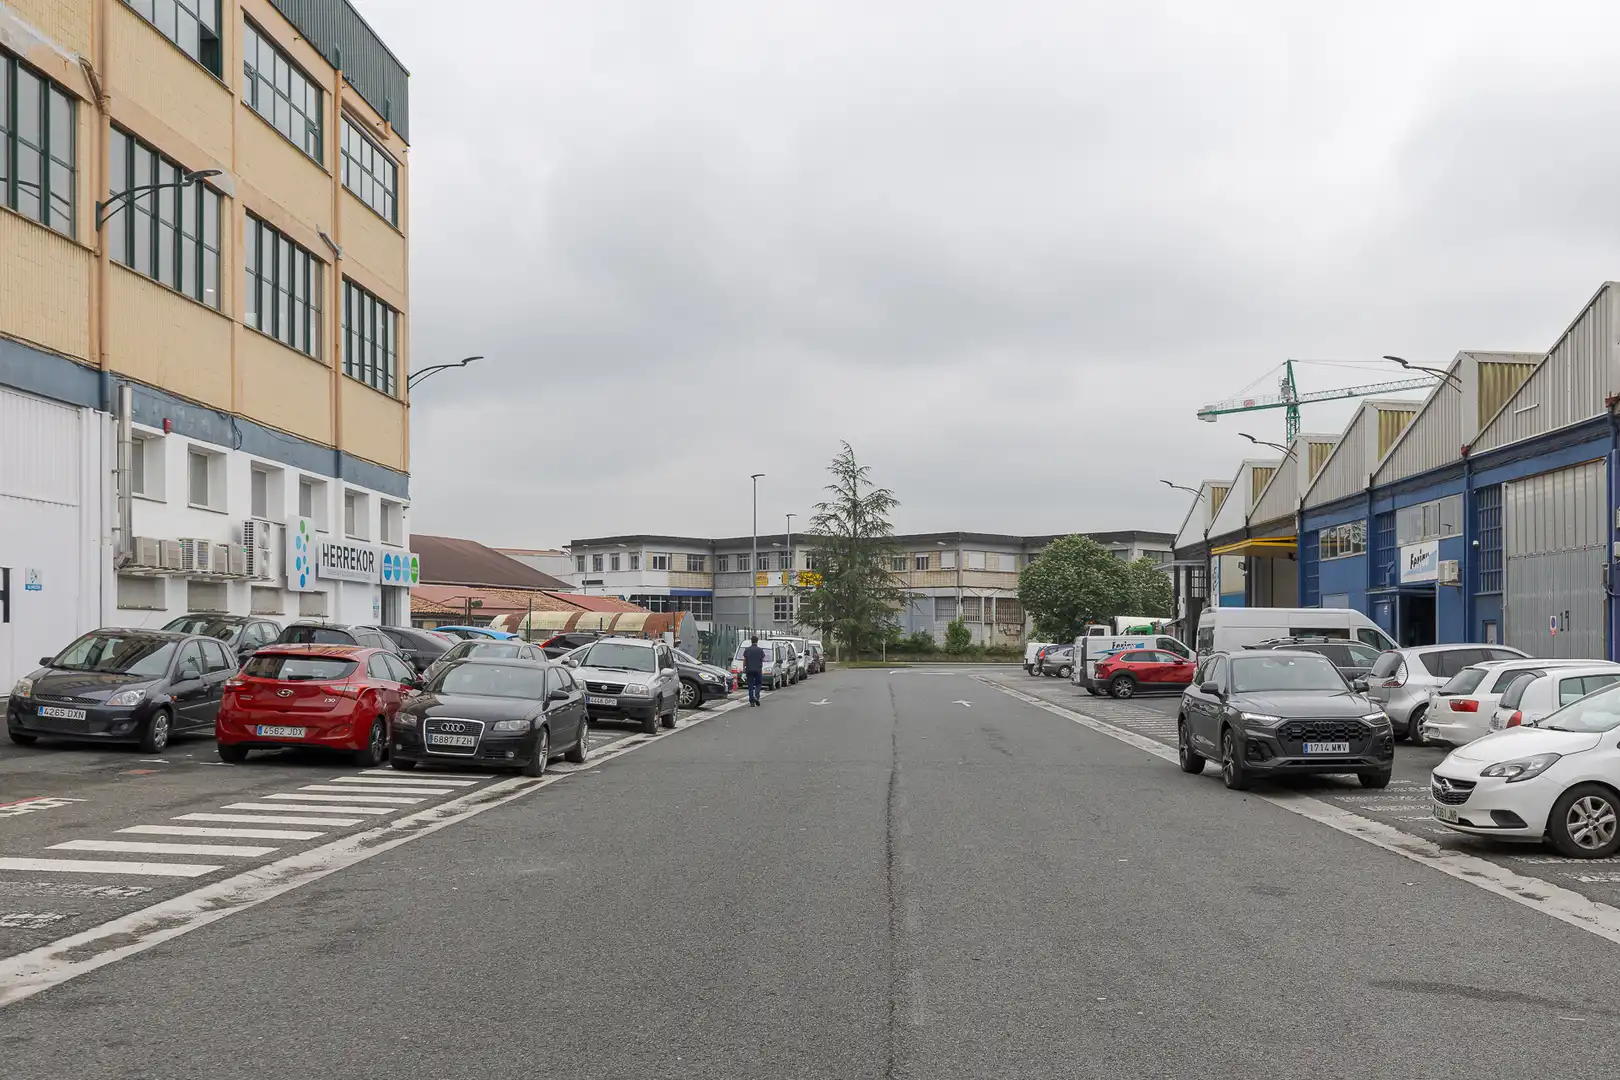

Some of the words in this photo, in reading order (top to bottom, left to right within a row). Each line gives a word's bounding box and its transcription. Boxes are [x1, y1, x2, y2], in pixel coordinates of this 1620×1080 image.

[322, 543, 375, 573] HERREKOR
[44, 708, 65, 717] 4265
[67, 710, 84, 719] DXN
[263, 727, 285, 735] 4562
[287, 728, 304, 736] JDX
[433, 735, 454, 744] 6887
[1310, 743, 1329, 752] 1714
